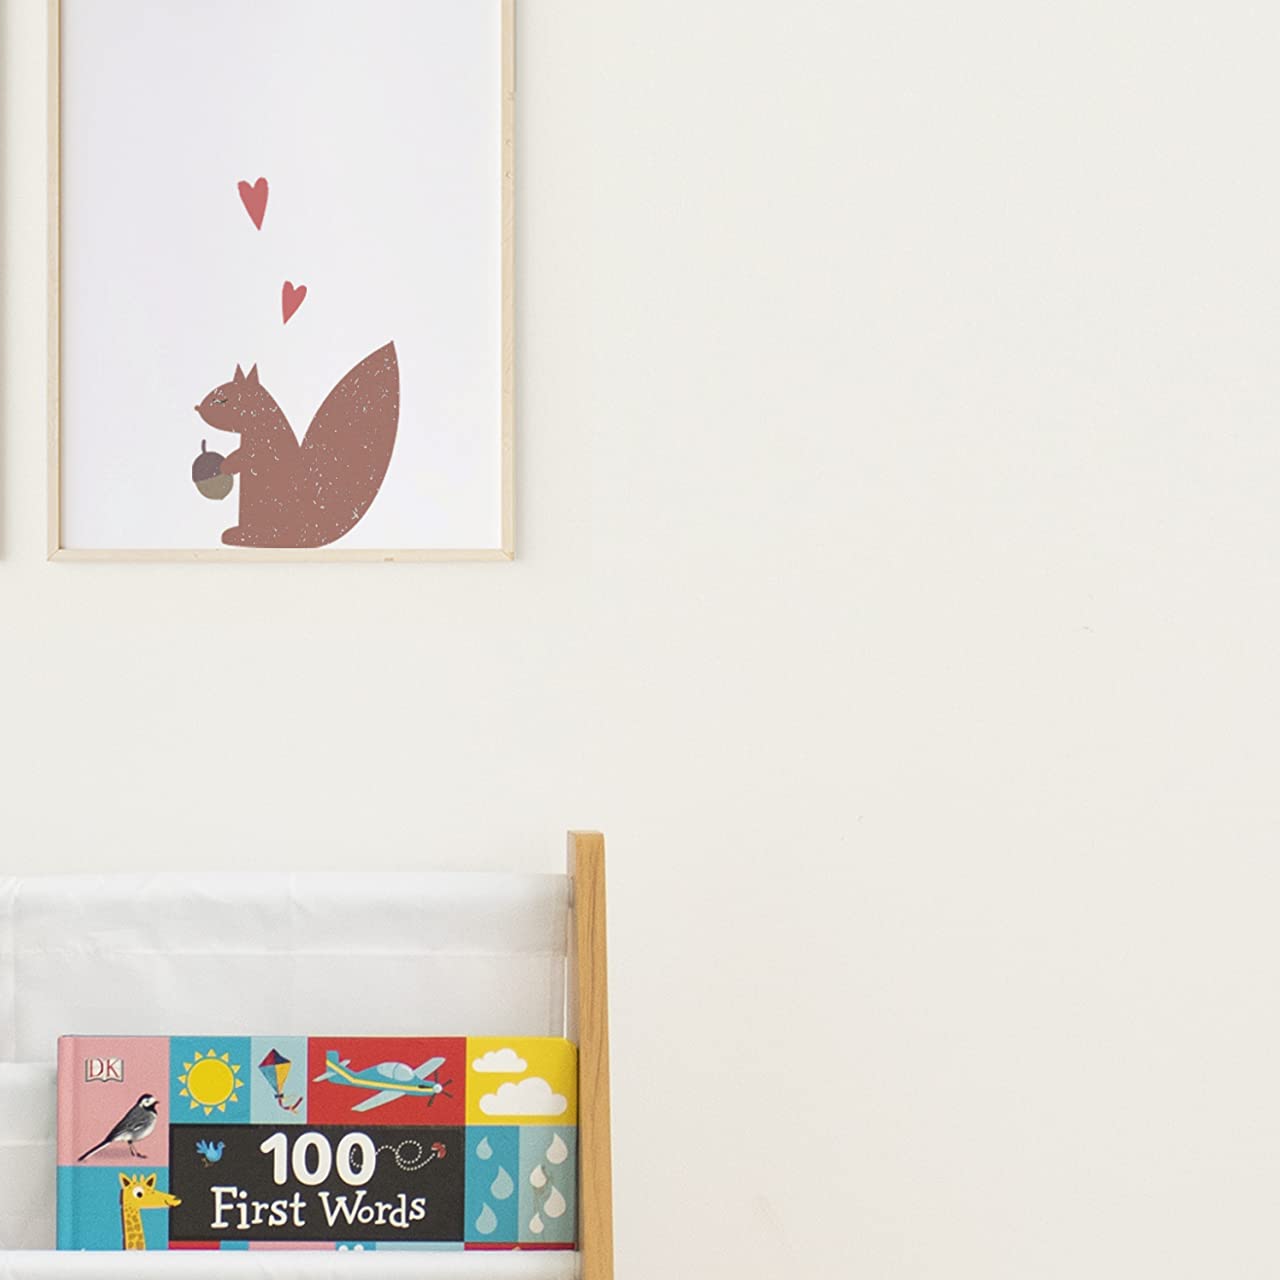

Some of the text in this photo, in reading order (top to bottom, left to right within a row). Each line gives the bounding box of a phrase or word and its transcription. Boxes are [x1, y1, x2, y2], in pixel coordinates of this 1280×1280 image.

[89, 1057, 120, 1078] DK
[259, 1131, 376, 1186] 100
[210, 1186, 426, 1229] First Words
